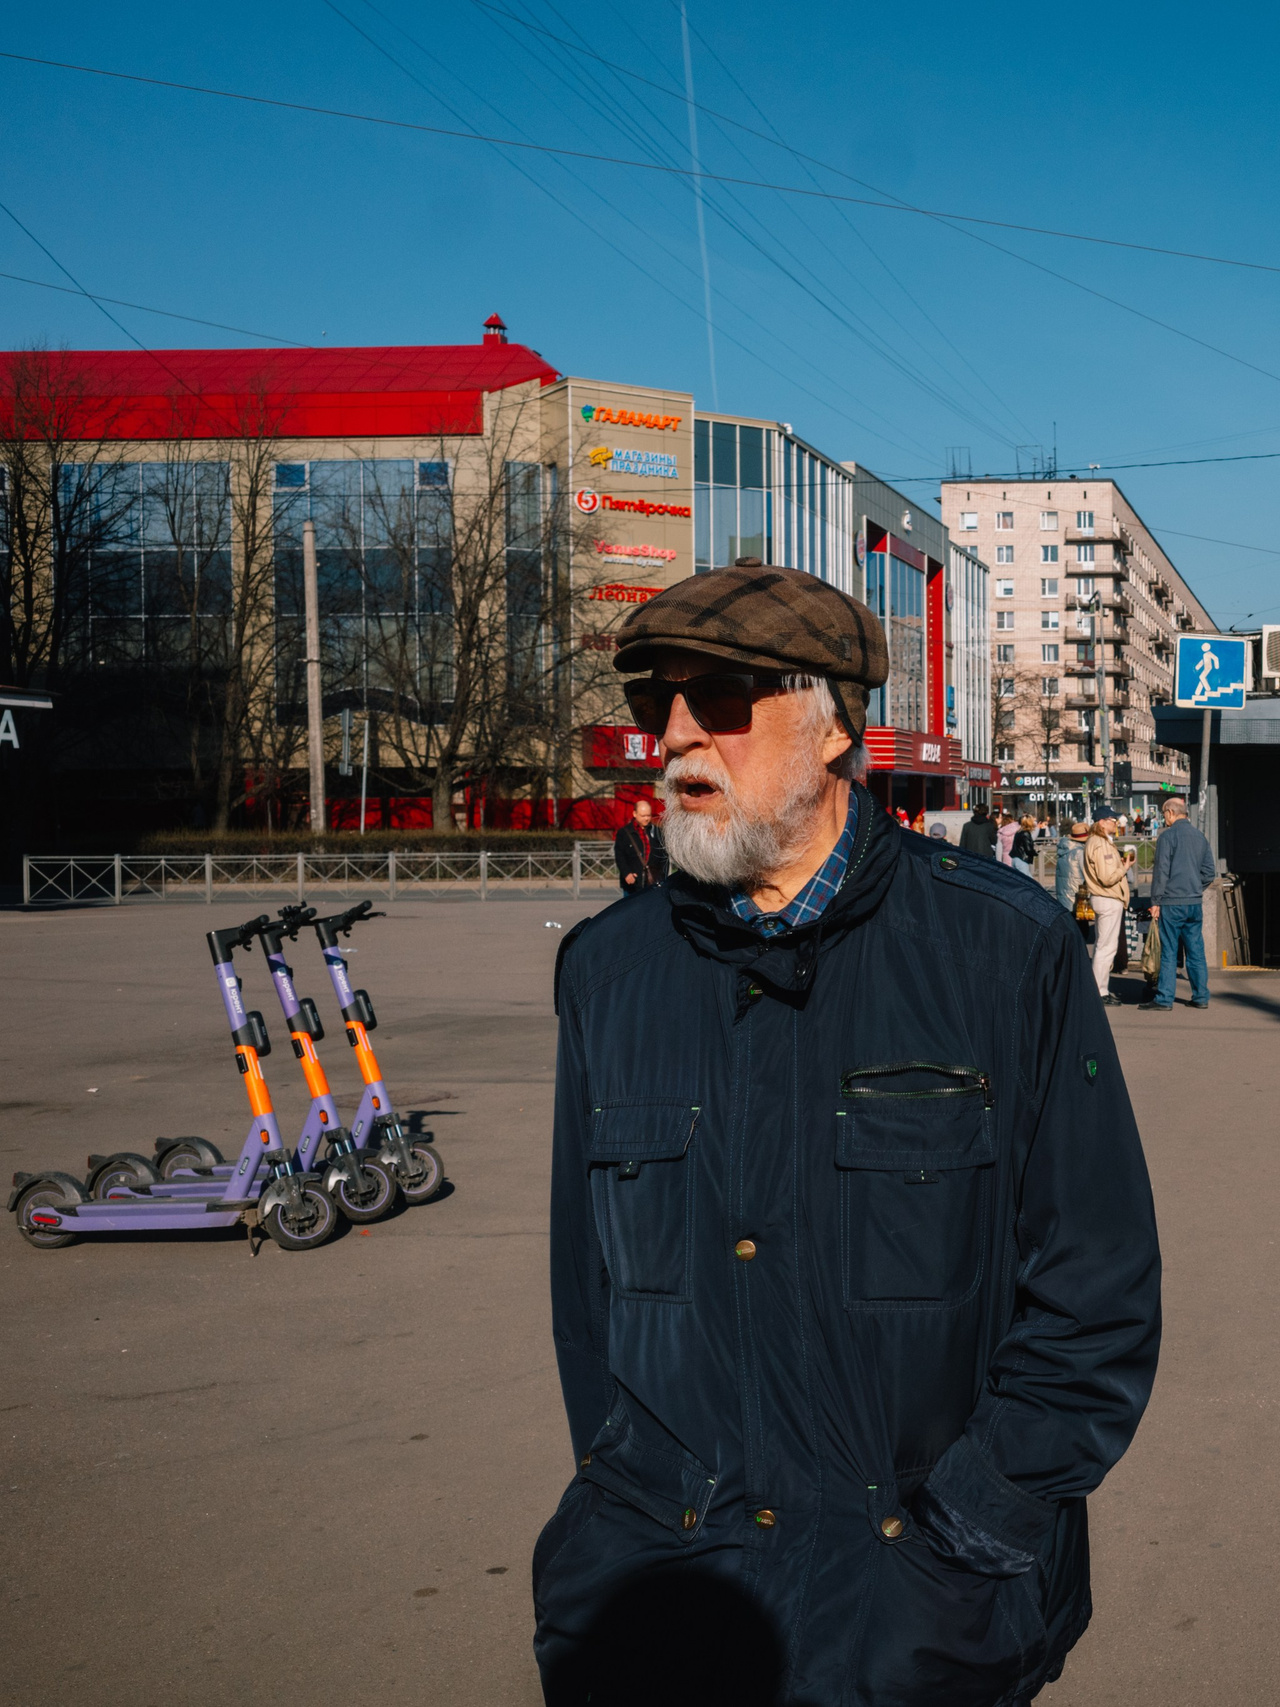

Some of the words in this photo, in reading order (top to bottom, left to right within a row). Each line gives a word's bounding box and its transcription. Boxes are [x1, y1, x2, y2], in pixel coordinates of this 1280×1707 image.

[595, 406, 682, 431] ГАЛАМАРТ
[614, 449, 677, 466] МАГАЗИНЫ
[611, 460, 679, 479] ПРАЗДНИКА
[602, 495, 691, 517] Пятёрочка
[594, 540, 677, 562] VenusShop
[589, 586, 657, 603] Леона
[230, 988, 243, 1014] юрент
